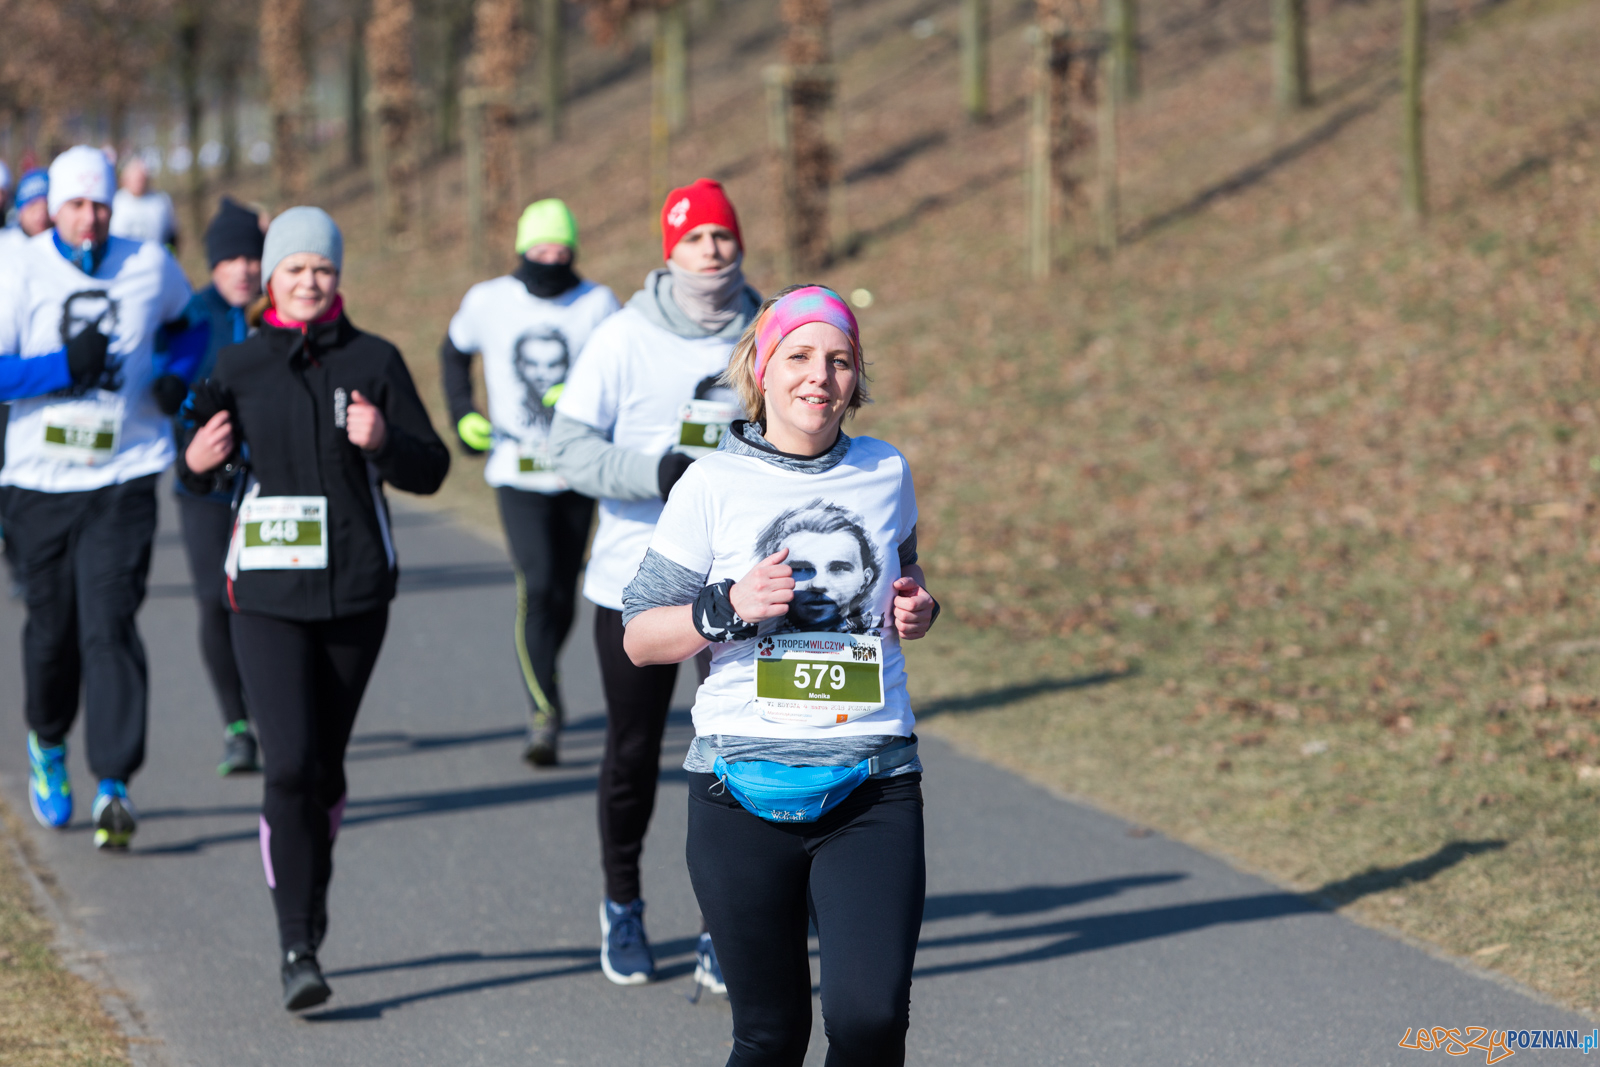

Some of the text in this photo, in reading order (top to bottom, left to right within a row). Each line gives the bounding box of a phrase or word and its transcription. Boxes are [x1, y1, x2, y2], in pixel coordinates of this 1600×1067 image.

[260, 519, 299, 542] 648
[777, 639, 845, 651] TROPEMWILCZYM
[793, 663, 846, 690] 579
